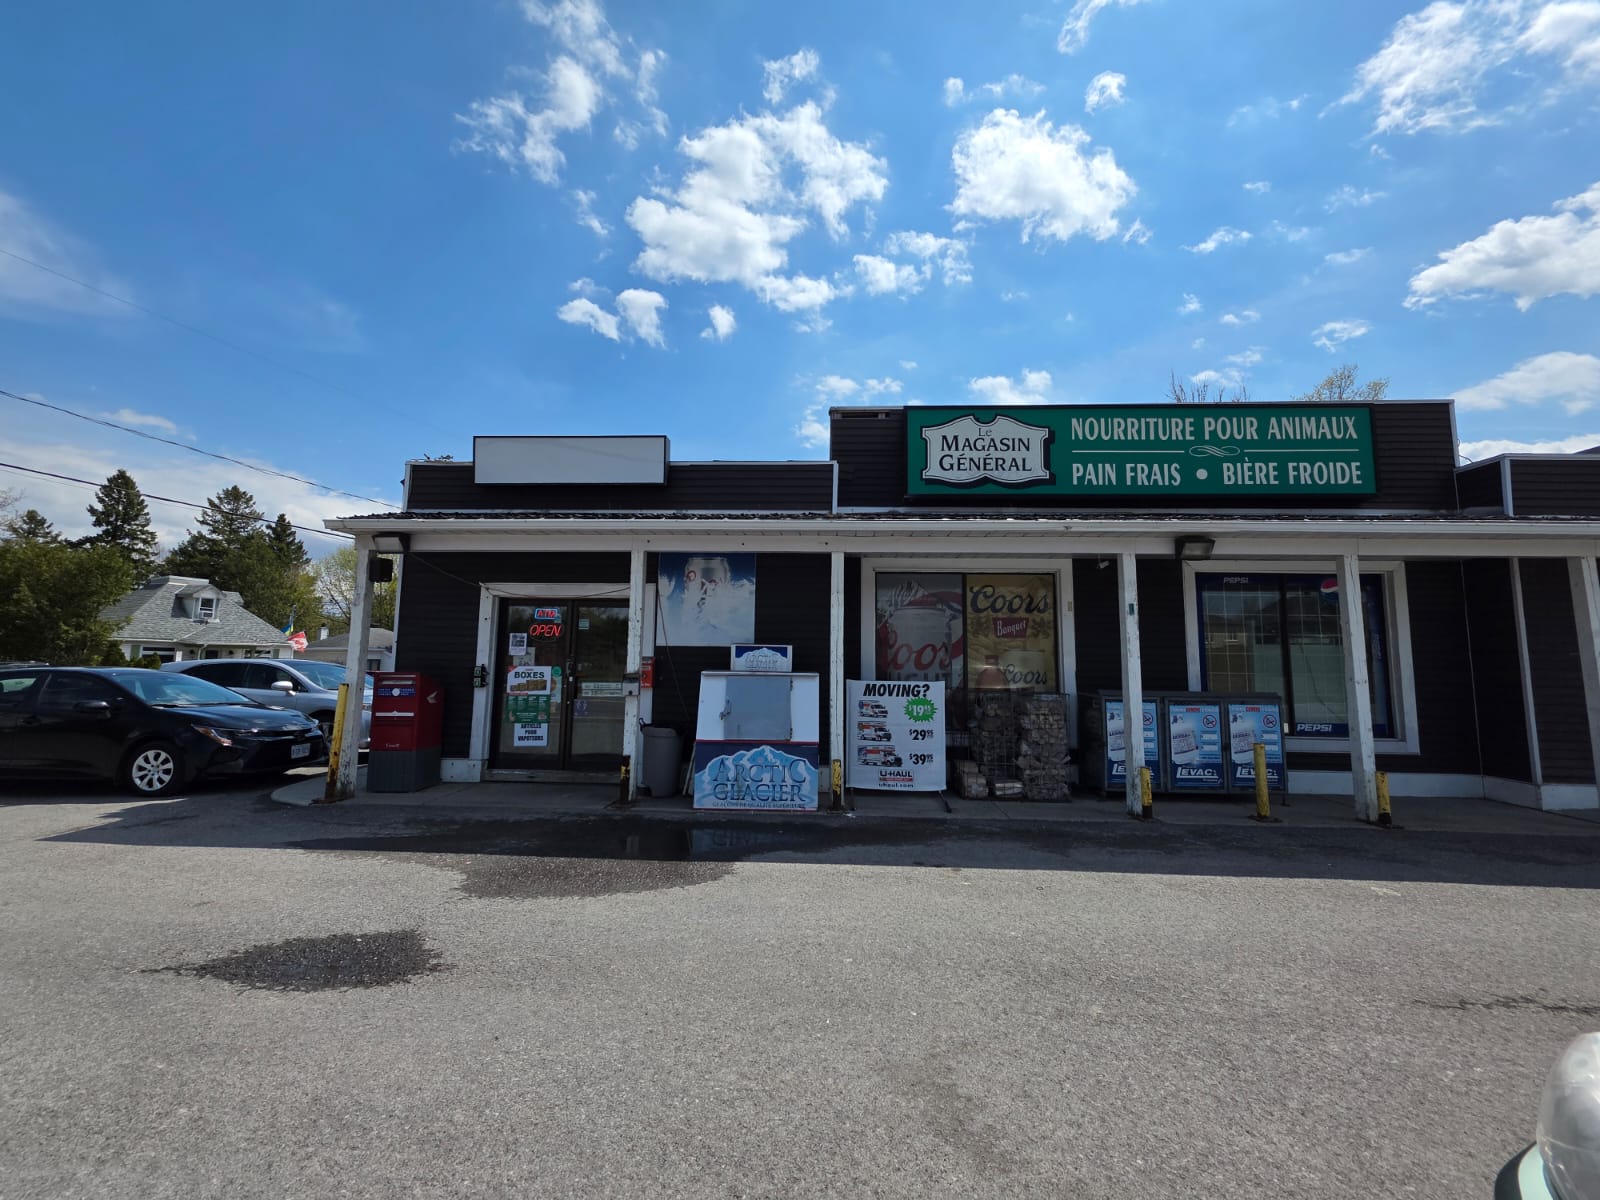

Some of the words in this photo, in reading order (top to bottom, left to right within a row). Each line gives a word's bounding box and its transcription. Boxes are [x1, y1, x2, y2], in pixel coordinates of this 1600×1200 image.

[979, 428, 992, 437] Le
[1071, 416, 1195, 441] NOURRITURE
[1204, 416, 1259, 440] POUR
[1268, 415, 1359, 440] ANIMAUX
[942, 435, 1030, 452] MAGASIN
[939, 453, 1032, 472] GÉNÉRAL
[1072, 463, 1117, 486] PAIN
[1126, 463, 1181, 486] FRAIS
[1223, 457, 1279, 485] BIÈRE
[1288, 462, 1363, 484] FROIDE
[1223, 576, 1249, 584] PEPSI
[969, 584, 1049, 613] Coors
[537, 610, 557, 618] ATM
[529, 624, 563, 637] OPEN
[996, 620, 1027, 637] Banquet
[514, 671, 546, 679] BOXES
[863, 683, 930, 698] MOVING?
[1296, 723, 1333, 732] PEPSI
[711, 758, 807, 784] ARCTIC
[1176, 767, 1214, 779] LEVAC
[1236, 767, 1274, 779] LEVC
[713, 783, 807, 802] GLACIER
